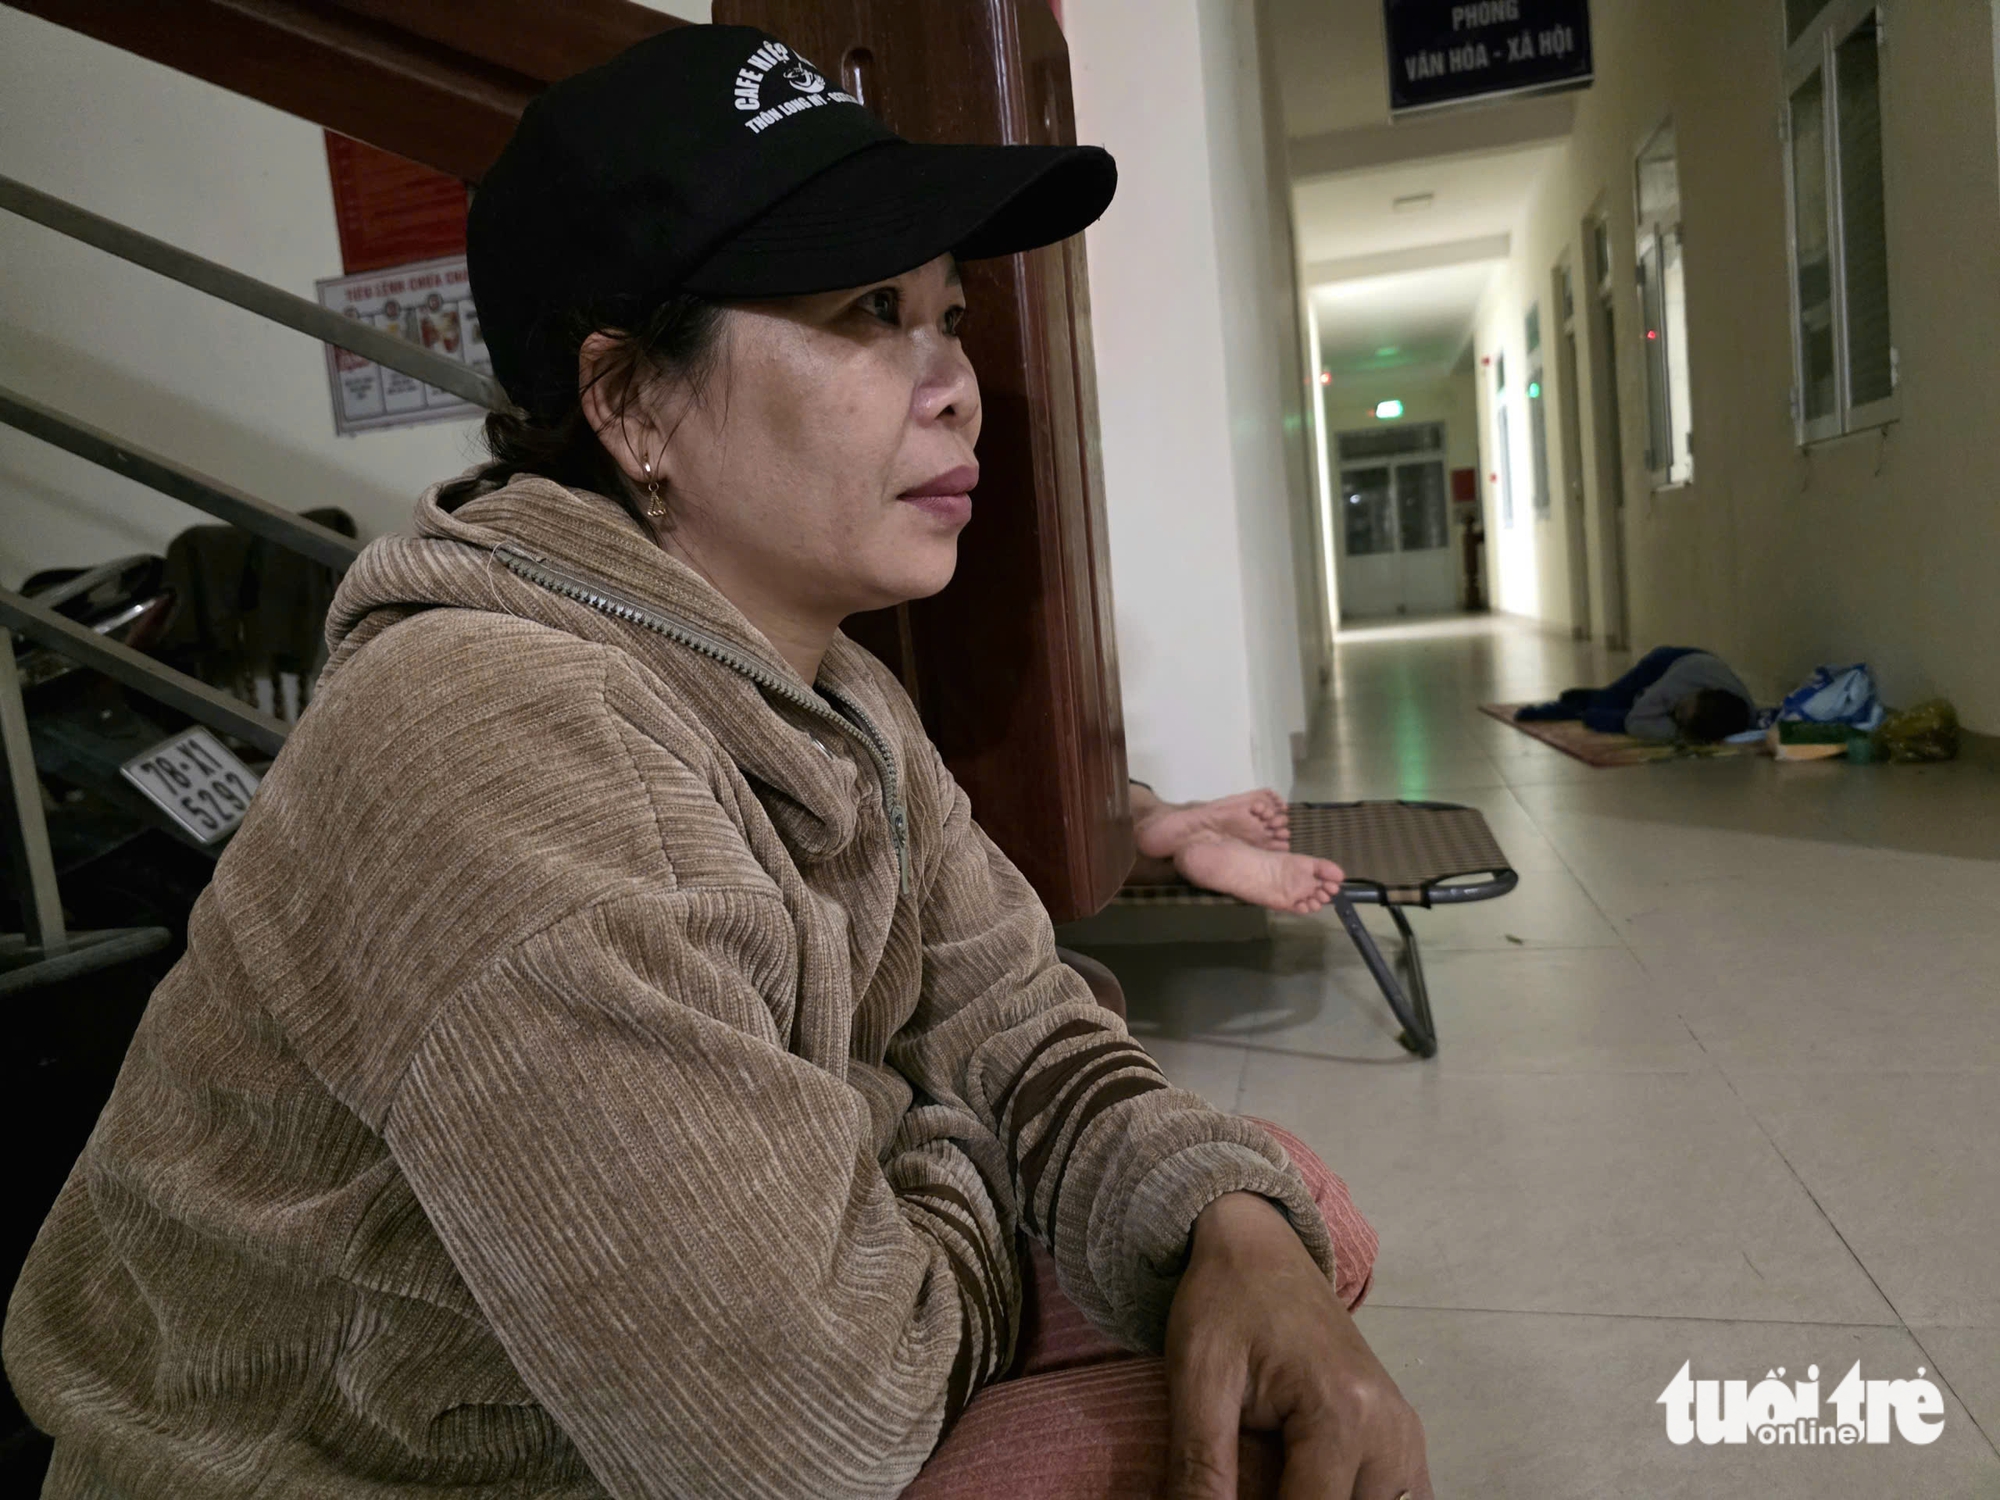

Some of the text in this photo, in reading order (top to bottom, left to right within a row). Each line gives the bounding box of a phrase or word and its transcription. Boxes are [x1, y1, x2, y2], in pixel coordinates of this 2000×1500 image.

[734, 68, 764, 111] CAFE
[744, 107, 784, 134] THÔN
[777, 97, 813, 116] LONG
